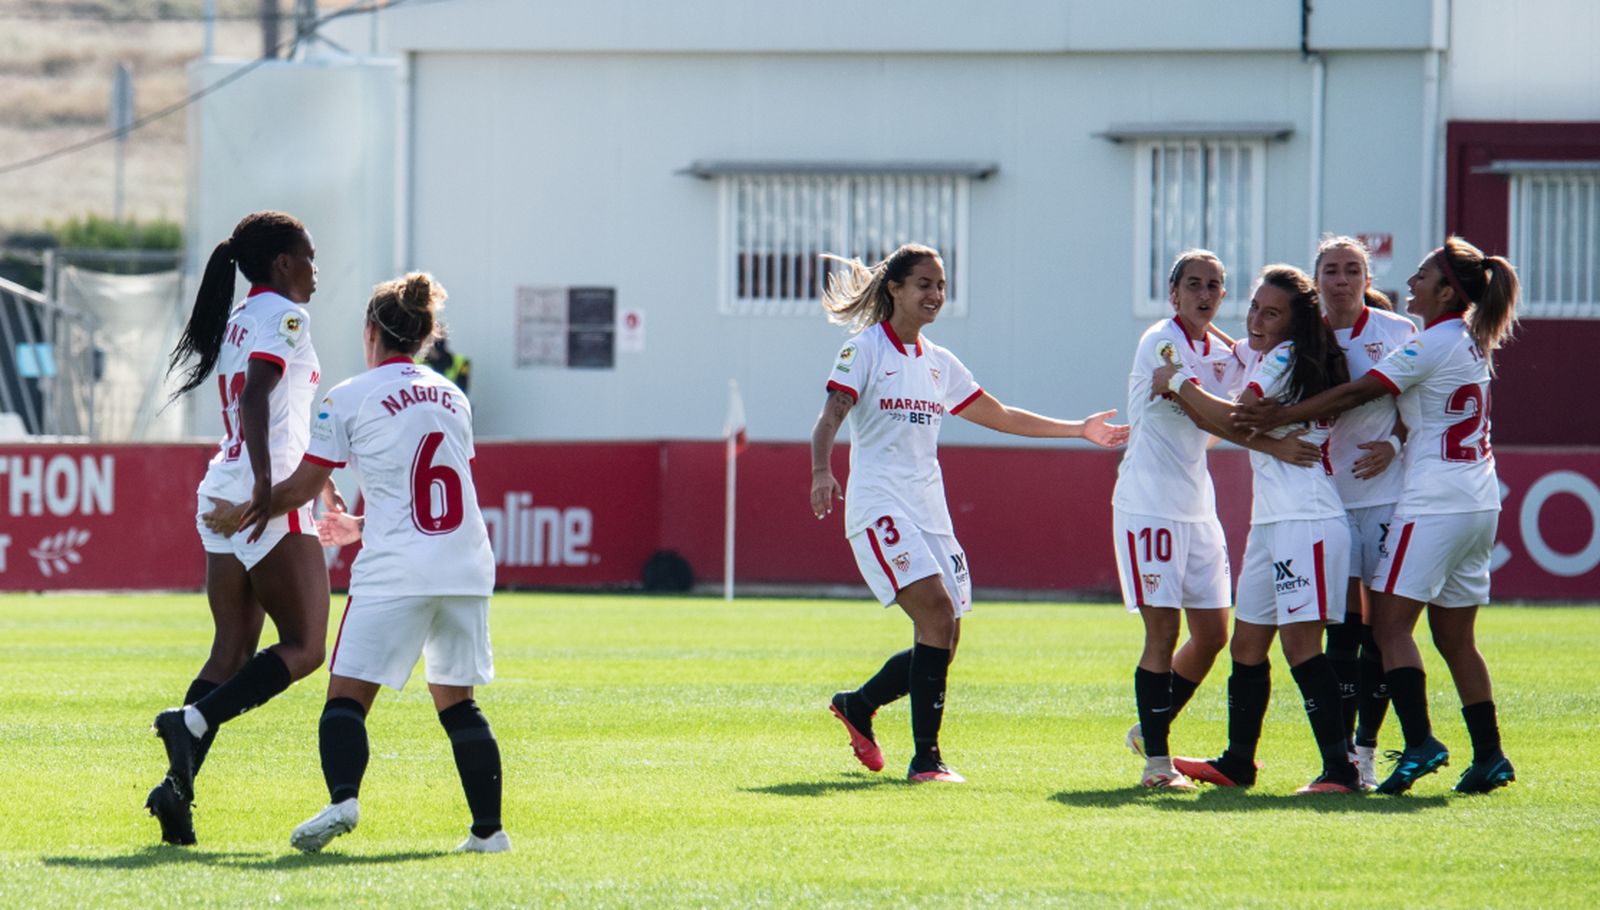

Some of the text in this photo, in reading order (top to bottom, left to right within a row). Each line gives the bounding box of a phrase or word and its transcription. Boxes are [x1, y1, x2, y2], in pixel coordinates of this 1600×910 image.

[909, 411, 932, 425] BET
[1441, 382, 1491, 463] 2
[0, 454, 114, 517] HON
[410, 431, 464, 536] 6
[876, 515, 900, 546] 3
[1139, 527, 1172, 562] 10
[1276, 575, 1310, 592] everfx
